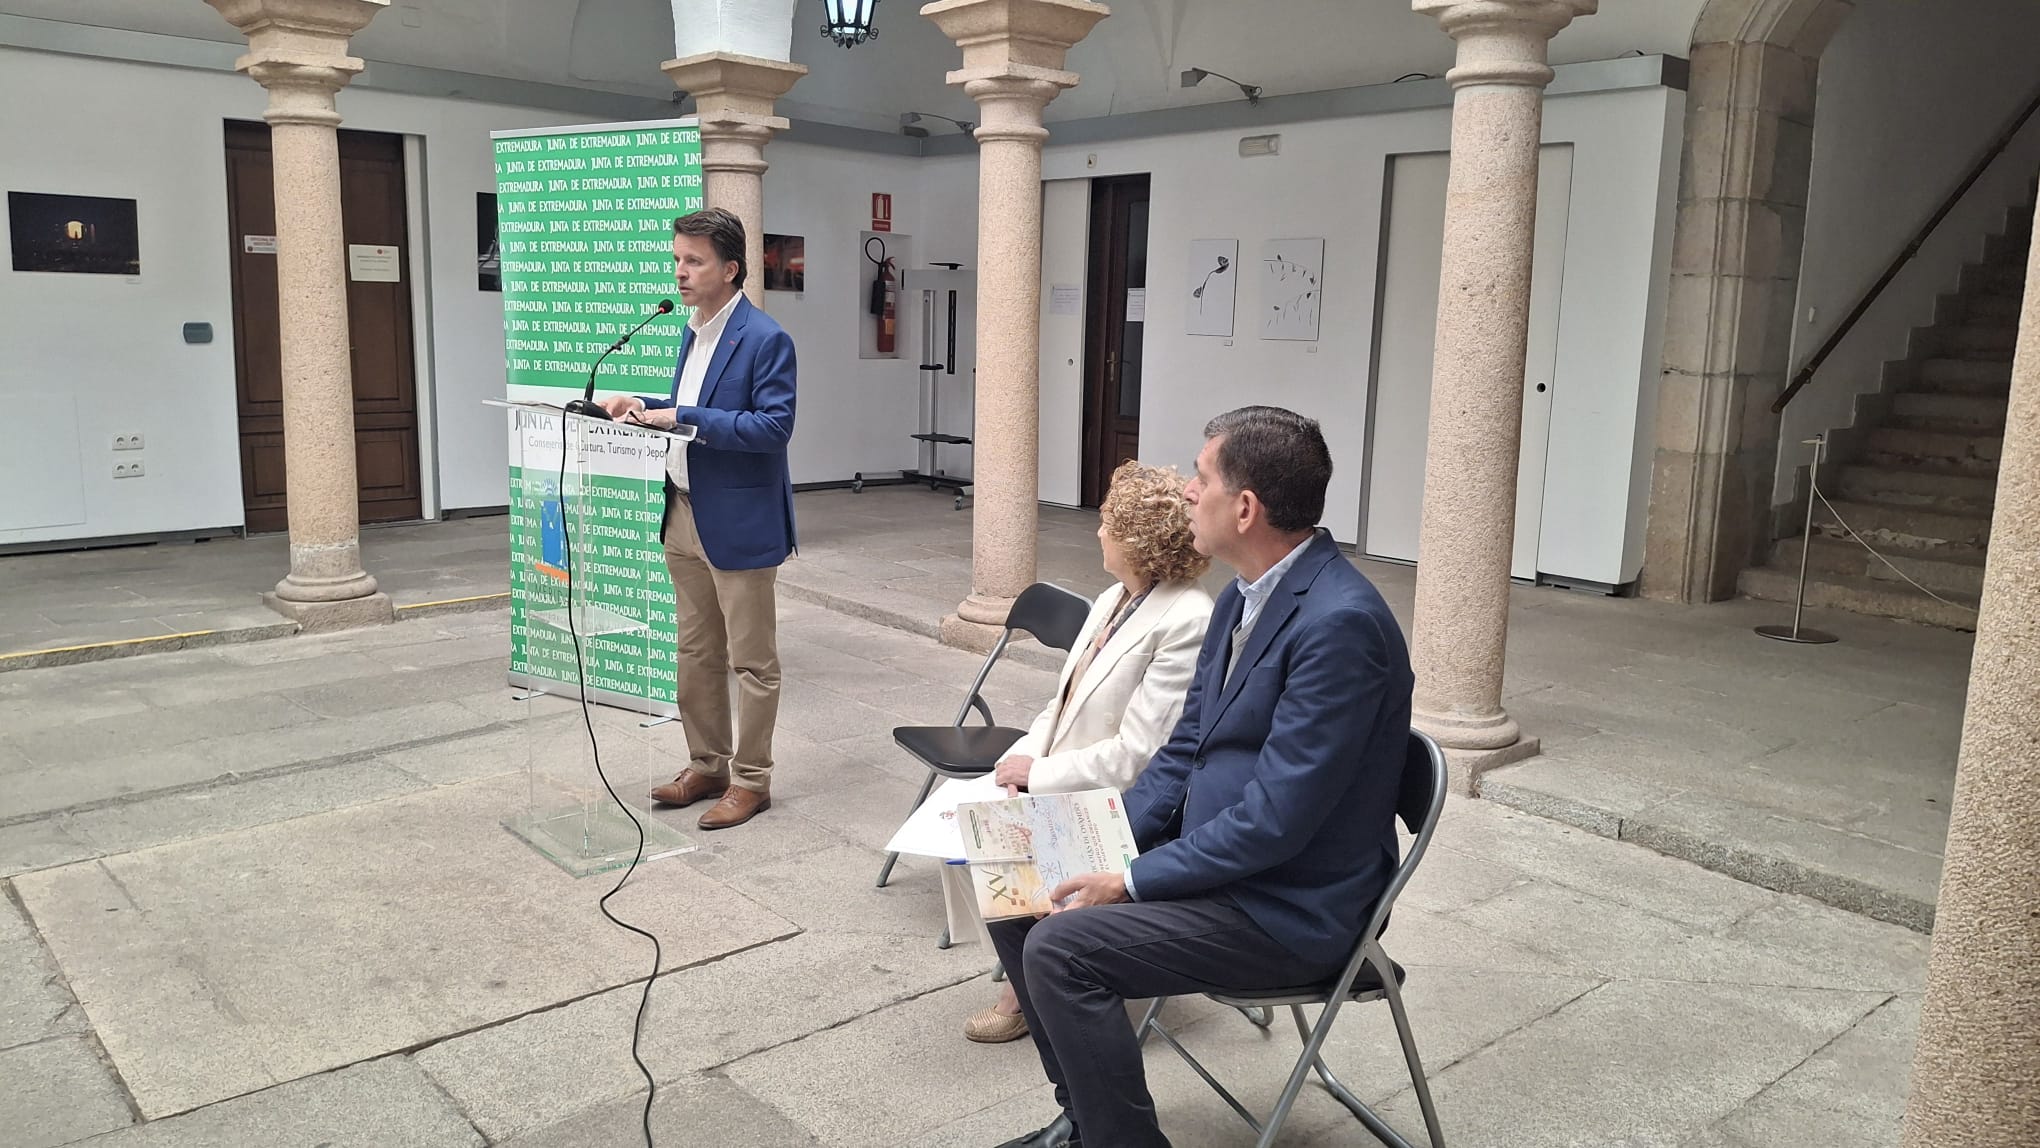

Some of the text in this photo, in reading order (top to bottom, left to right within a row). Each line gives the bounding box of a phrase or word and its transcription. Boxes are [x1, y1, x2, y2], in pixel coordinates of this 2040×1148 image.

[496, 140, 542, 153] EXTREMADURA
[547, 137, 566, 152] JUNTA
[570, 137, 578, 149] DE
[581, 135, 631, 148] EXTREMADURA
[636, 133, 657, 147] JUNTA
[661, 133, 669, 145] DE
[507, 161, 524, 174] JUNTA
[528, 160, 535, 172] DE
[538, 158, 586, 171] EXTREMADURA
[591, 157, 611, 171] JUNTA
[615, 156, 623, 168] DE
[627, 154, 678, 168] EXTREMADURA
[499, 181, 543, 193] EXTREMADURA
[549, 180, 568, 192] JUNTA
[571, 179, 579, 190] DE
[583, 177, 632, 190] EXTREMADURA
[637, 176, 658, 190] JUNTA
[662, 176, 670, 188] DE
[509, 202, 525, 215] JUNTA
[529, 201, 536, 212] DE
[540, 199, 587, 212] EXTREMADURA
[592, 199, 613, 212] JUNTA
[616, 198, 624, 210] DE
[628, 197, 679, 210] EXTREMADURA
[502, 219, 671, 233] EXTREMADURA JUNTA DE EXTREMADURA JUNTA DE
[510, 241, 526, 253] JUNTA
[530, 241, 537, 252] DE
[541, 241, 588, 252] EXTREMADURA
[594, 241, 613, 253] JUNTA
[617, 241, 625, 252] DE
[503, 262, 546, 273] EXTREMADURA
[551, 261, 570, 274] JUNTA
[574, 261, 581, 273] DE
[584, 261, 634, 273] EXTREMADURA
[640, 261, 659, 274] JUNTA
[664, 261, 672, 273] DE
[511, 281, 527, 292] JUNTA
[531, 281, 539, 292] DE
[543, 281, 589, 293] EXTREMADURA
[595, 282, 615, 295] JUNTA
[618, 282, 626, 294] DE
[629, 282, 680, 295] EXTREMADURA
[505, 301, 547, 313] EXTREMADURA
[552, 301, 571, 314] JUNTA
[575, 302, 582, 313] DE
[586, 302, 635, 314] EXTREMADURA
[512, 320, 529, 332] JUNTA
[532, 321, 540, 331] DE
[544, 321, 590, 333] EXTREMADURA
[596, 323, 615, 336] JUNTA
[619, 323, 627, 335] DE
[630, 323, 681, 336] EXTREMADURA
[506, 339, 548, 351] EXTREMADURA
[553, 341, 572, 354] JUNTA
[576, 342, 583, 353] DE
[641, 345, 661, 358] JUNTA
[665, 346, 673, 357] DE
[513, 358, 529, 370] JUNTA
[534, 359, 541, 370] DE
[545, 360, 592, 373] EXTREMADURA
[595, 363, 617, 376] JUNTA
[621, 364, 628, 375] DE
[608, 442, 636, 456] Turismo
[638, 448, 643, 459] y
[592, 486, 640, 501] EXTREMADURA
[602, 506, 621, 519] JUNTA
[624, 510, 632, 520] DE
[583, 524, 591, 534] DE
[592, 524, 641, 541] EXTREMADURA
[603, 545, 622, 558] JUNTA
[625, 548, 633, 559] DE
[584, 561, 592, 573] DE
[594, 563, 641, 580] EXTREMADURA
[603, 583, 622, 596] JUNTA
[626, 587, 634, 598] DE
[595, 600, 642, 618] EXTREMADURA
[669, 613, 677, 624] DE
[586, 638, 593, 648] DE
[596, 639, 642, 656] EXTREMADURA
[669, 651, 677, 663] DE
[542, 648, 550, 658] DE
[605, 659, 623, 672] JUNTA
[627, 663, 635, 674] DE
[561, 670, 579, 683] JUNTA
[587, 675, 593, 686] DE
[596, 676, 642, 695] EXTREMADURA
[670, 690, 677, 701] DE
